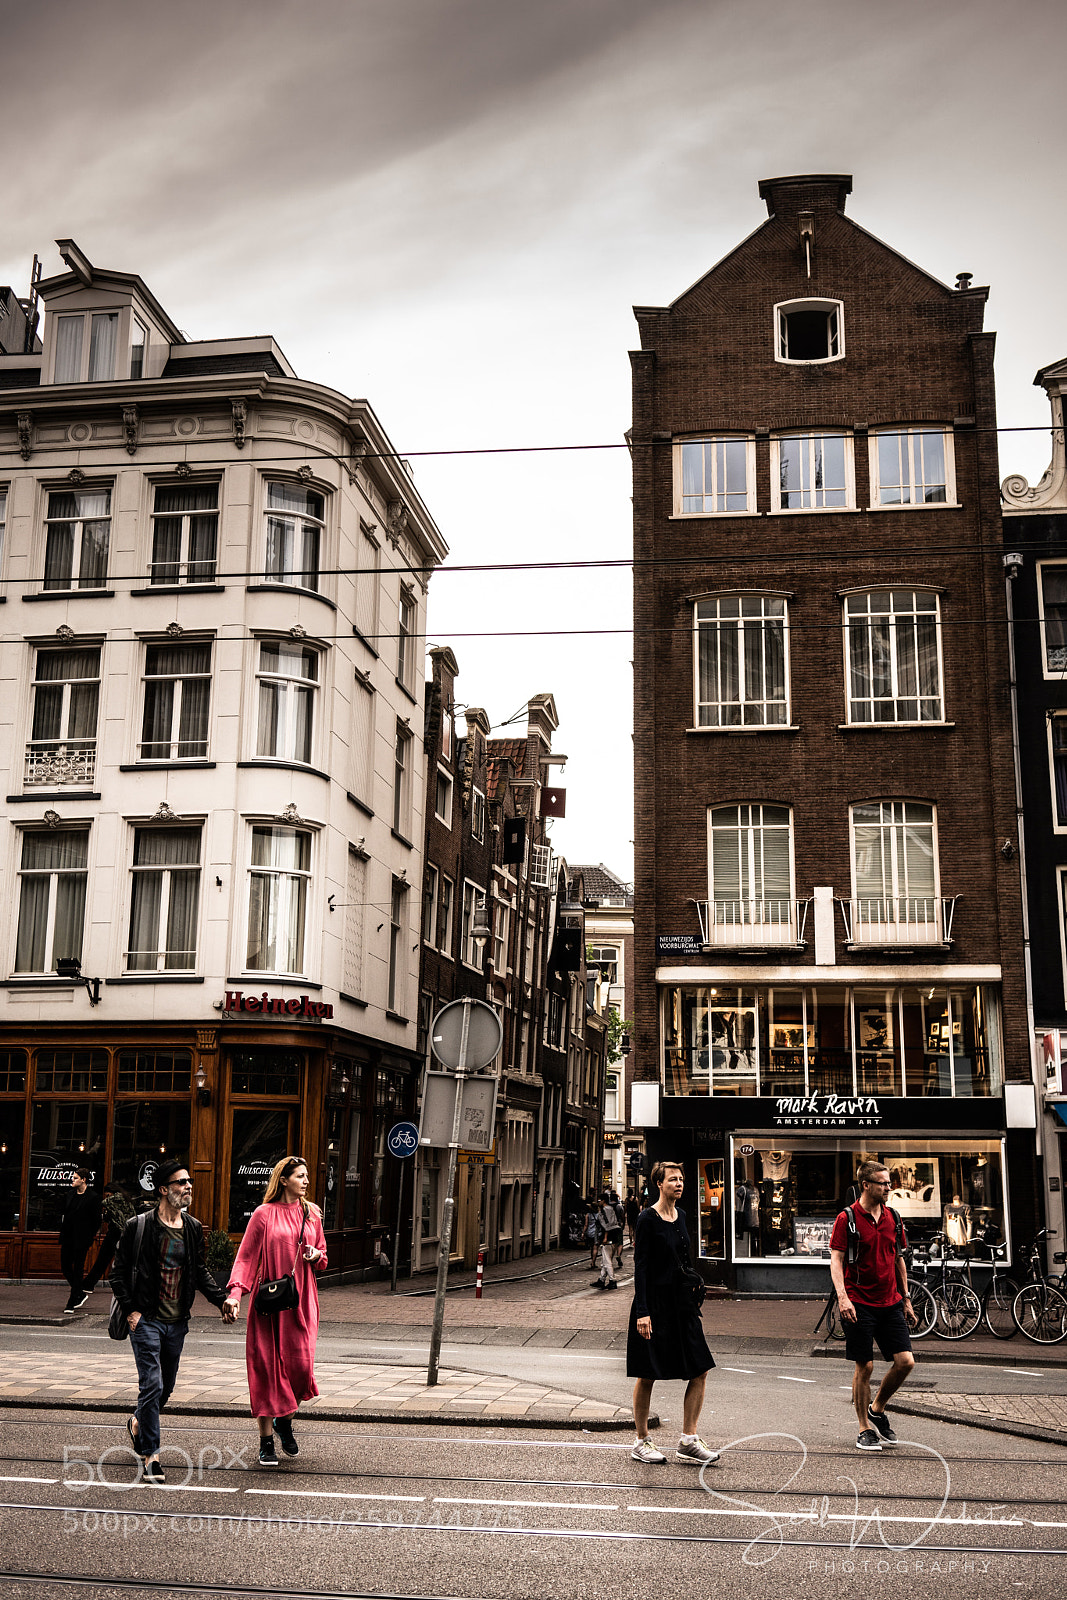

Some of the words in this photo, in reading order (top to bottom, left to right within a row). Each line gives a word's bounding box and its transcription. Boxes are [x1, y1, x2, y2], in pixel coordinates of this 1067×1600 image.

[224, 991, 334, 1019] Heineken
[824, 1093, 880, 1115] Raven
[37, 1168, 96, 1181] HULSCH'S
